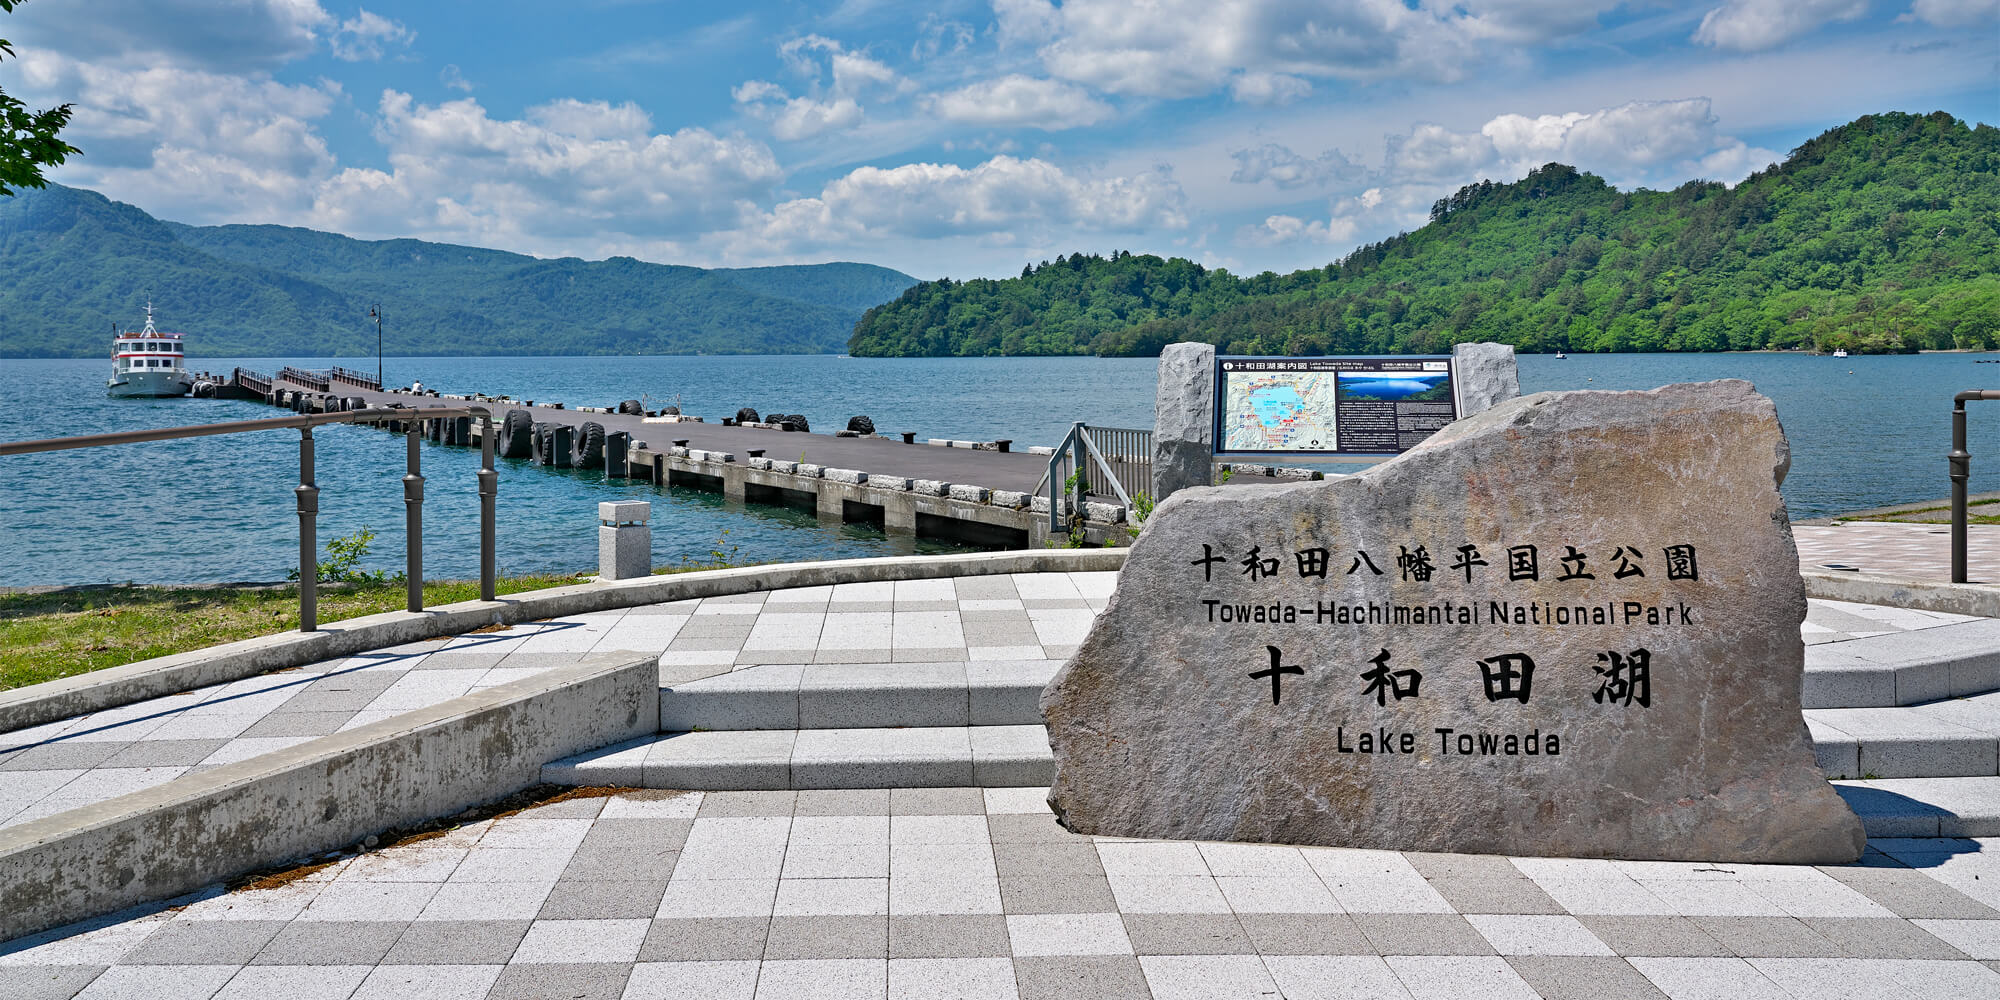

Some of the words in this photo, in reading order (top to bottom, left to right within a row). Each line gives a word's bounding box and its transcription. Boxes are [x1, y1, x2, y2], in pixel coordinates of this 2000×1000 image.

[1191, 543, 1699, 583] 十和田八幡平国立公園
[1203, 600, 1480, 626] Towada-Hachimantai
[1491, 602, 1616, 626] National
[1625, 602, 1694, 627] Park
[1248, 645, 1652, 708] 十和田湖
[1337, 727, 1415, 755] Lake
[1435, 728, 1561, 756] Towada
